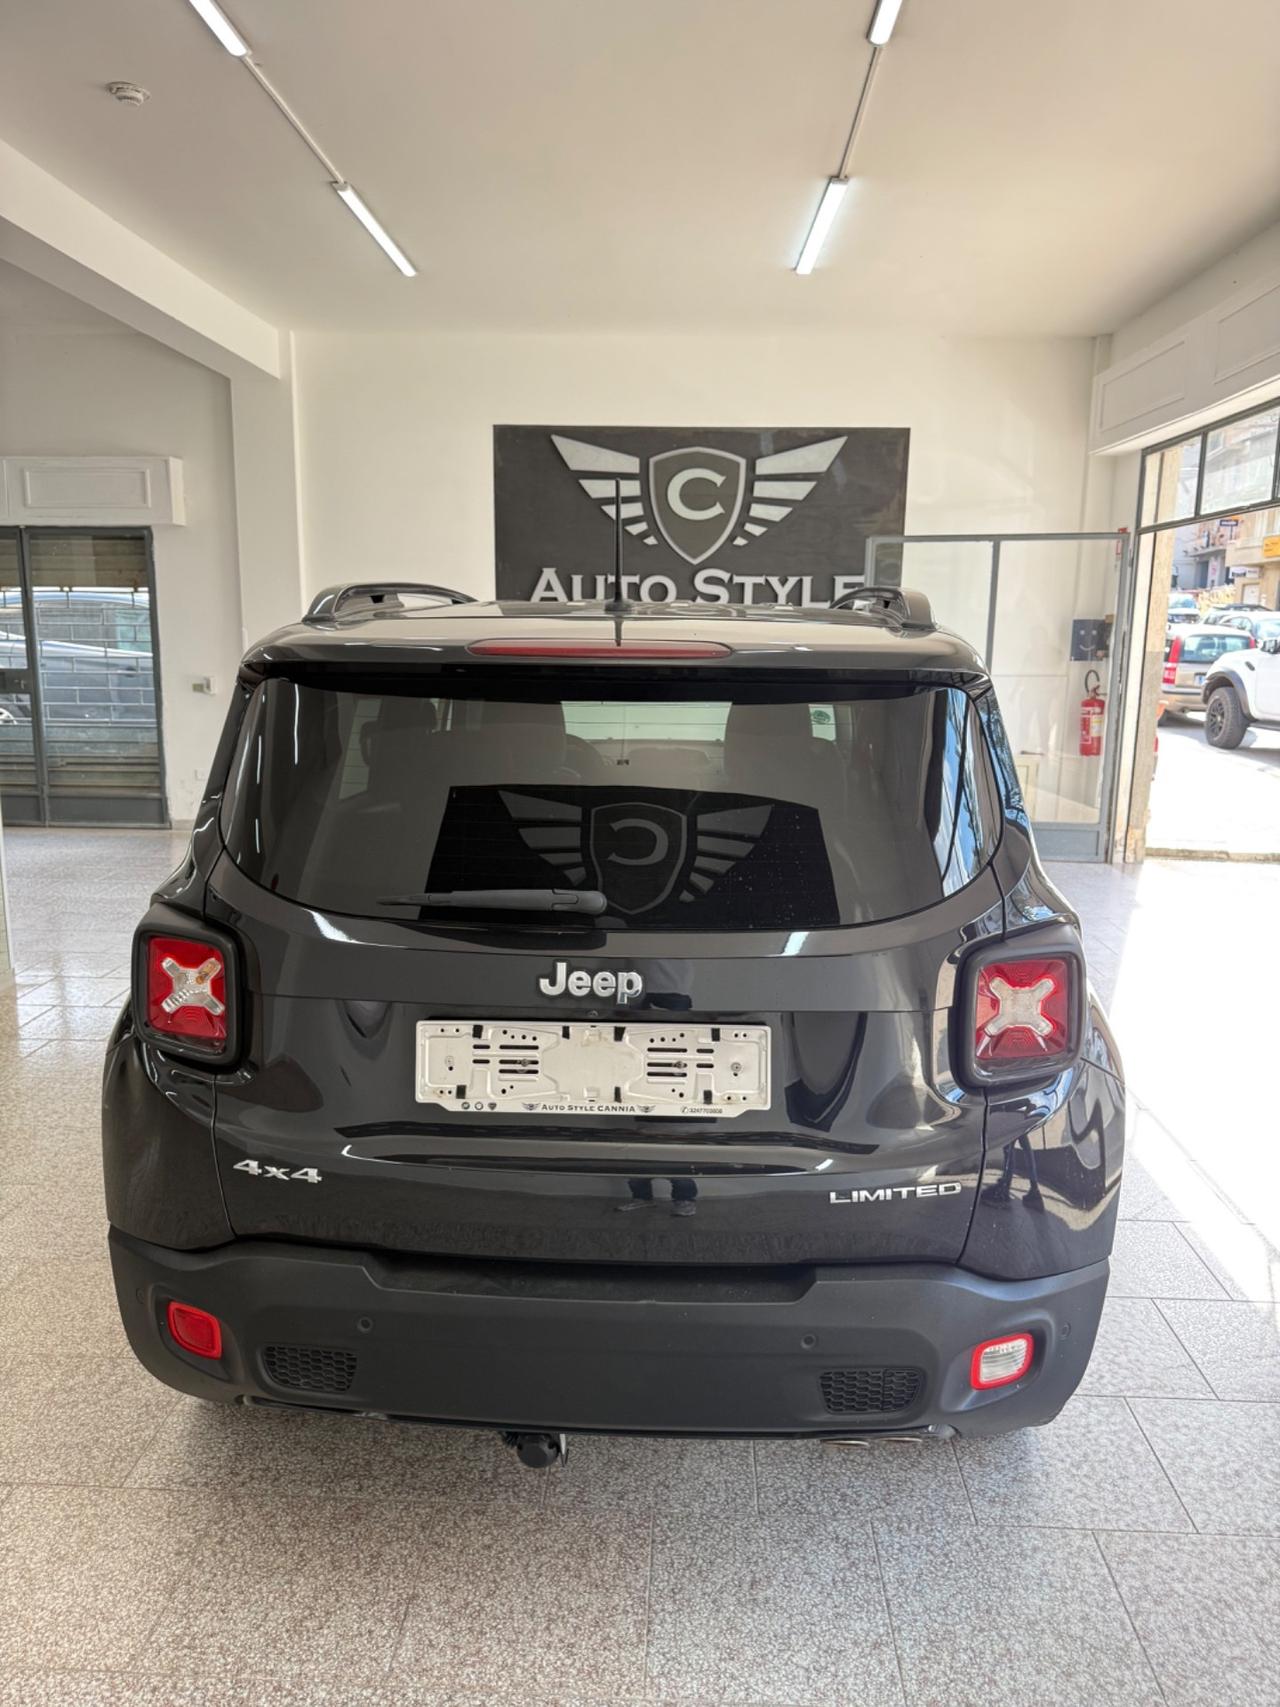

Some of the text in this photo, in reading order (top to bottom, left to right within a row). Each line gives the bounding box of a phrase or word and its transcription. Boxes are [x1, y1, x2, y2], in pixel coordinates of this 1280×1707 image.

[667, 467, 726, 521] C
[529, 567, 677, 603] AUTO
[539, 962, 643, 1004] Jeep
[541, 1103, 565, 1111] AUTO
[567, 1104, 596, 1112] STYLE
[597, 1105, 636, 1113] CANNIA
[233, 1160, 322, 1183] 4x4
[830, 1182, 962, 1204] LIMITED
